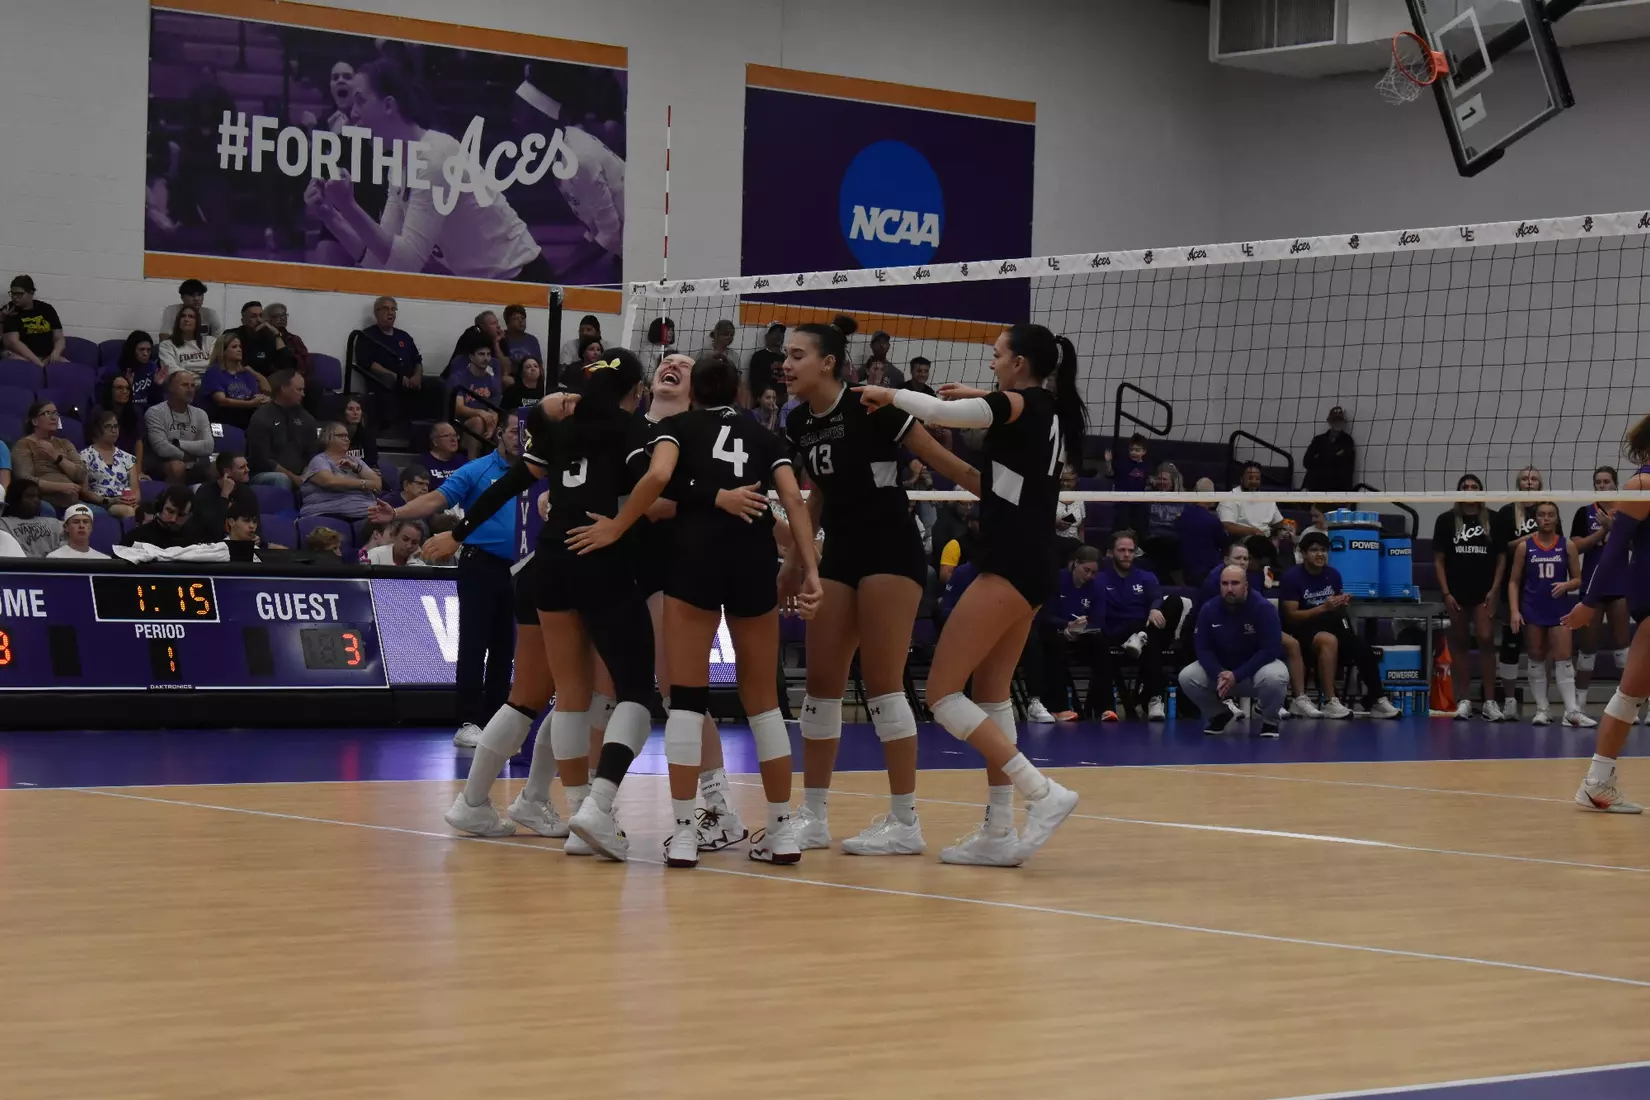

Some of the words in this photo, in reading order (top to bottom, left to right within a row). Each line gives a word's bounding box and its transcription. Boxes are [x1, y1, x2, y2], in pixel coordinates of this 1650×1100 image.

[849, 204, 940, 248] NCAA
[1048, 258, 1060, 271] UE
[1091, 254, 1111, 268] Aces
[1187, 247, 1207, 262] Aces
[1241, 243, 1254, 257] UE
[1290, 239, 1311, 254] Aces
[1398, 231, 1421, 246] Aces
[1460, 227, 1474, 242] UE
[1515, 222, 1539, 238] Aces
[712, 425, 749, 477] 4
[808, 443, 835, 476] 13
[1453, 523, 1485, 544] Ace
[1538, 562, 1555, 579] 10
[0, 588, 47, 617] ME
[136, 583, 211, 615] 1:15
[255, 592, 340, 621] GUEST
[134, 623, 186, 640] PERIOD
[167, 646, 176, 673] 1
[342, 633, 362, 666] 3
[1388, 670, 1419, 680] POWERADE
